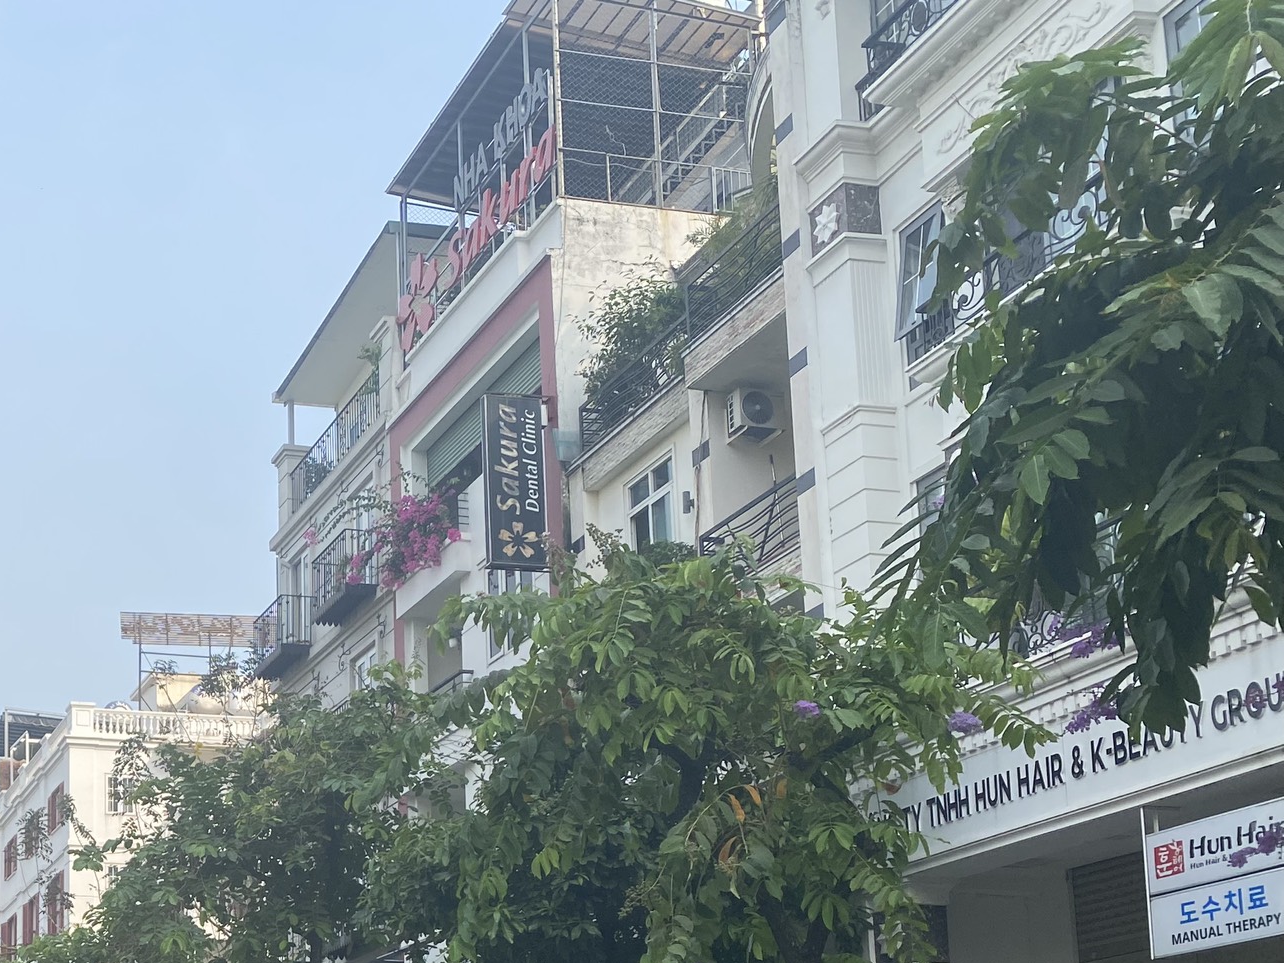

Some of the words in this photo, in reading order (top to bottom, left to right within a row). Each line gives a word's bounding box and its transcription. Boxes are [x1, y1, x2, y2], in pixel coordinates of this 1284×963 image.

[453, 142, 489, 211] NHA
[493, 67, 548, 161] KHOA
[444, 124, 556, 289] Sakura
[521, 409, 536, 455] Clinic
[494, 403, 521, 515] Sakura
[522, 458, 539, 513] Dental
[926, 790, 971, 828] TNHH
[975, 770, 1012, 809] HUN
[1017, 753, 1065, 798] HAIR
[1071, 746, 1084, 779] &
[1211, 672, 1284, 731] GROU
[1189, 836, 1232, 858] Hun
[1190, 861, 1204, 870] Hun
[1205, 857, 1220, 866] Hair
[1172, 925, 1224, 945] MANUAL
[1225, 912, 1281, 935] THERAPY
[1180, 885, 1269, 925] 도수치료
